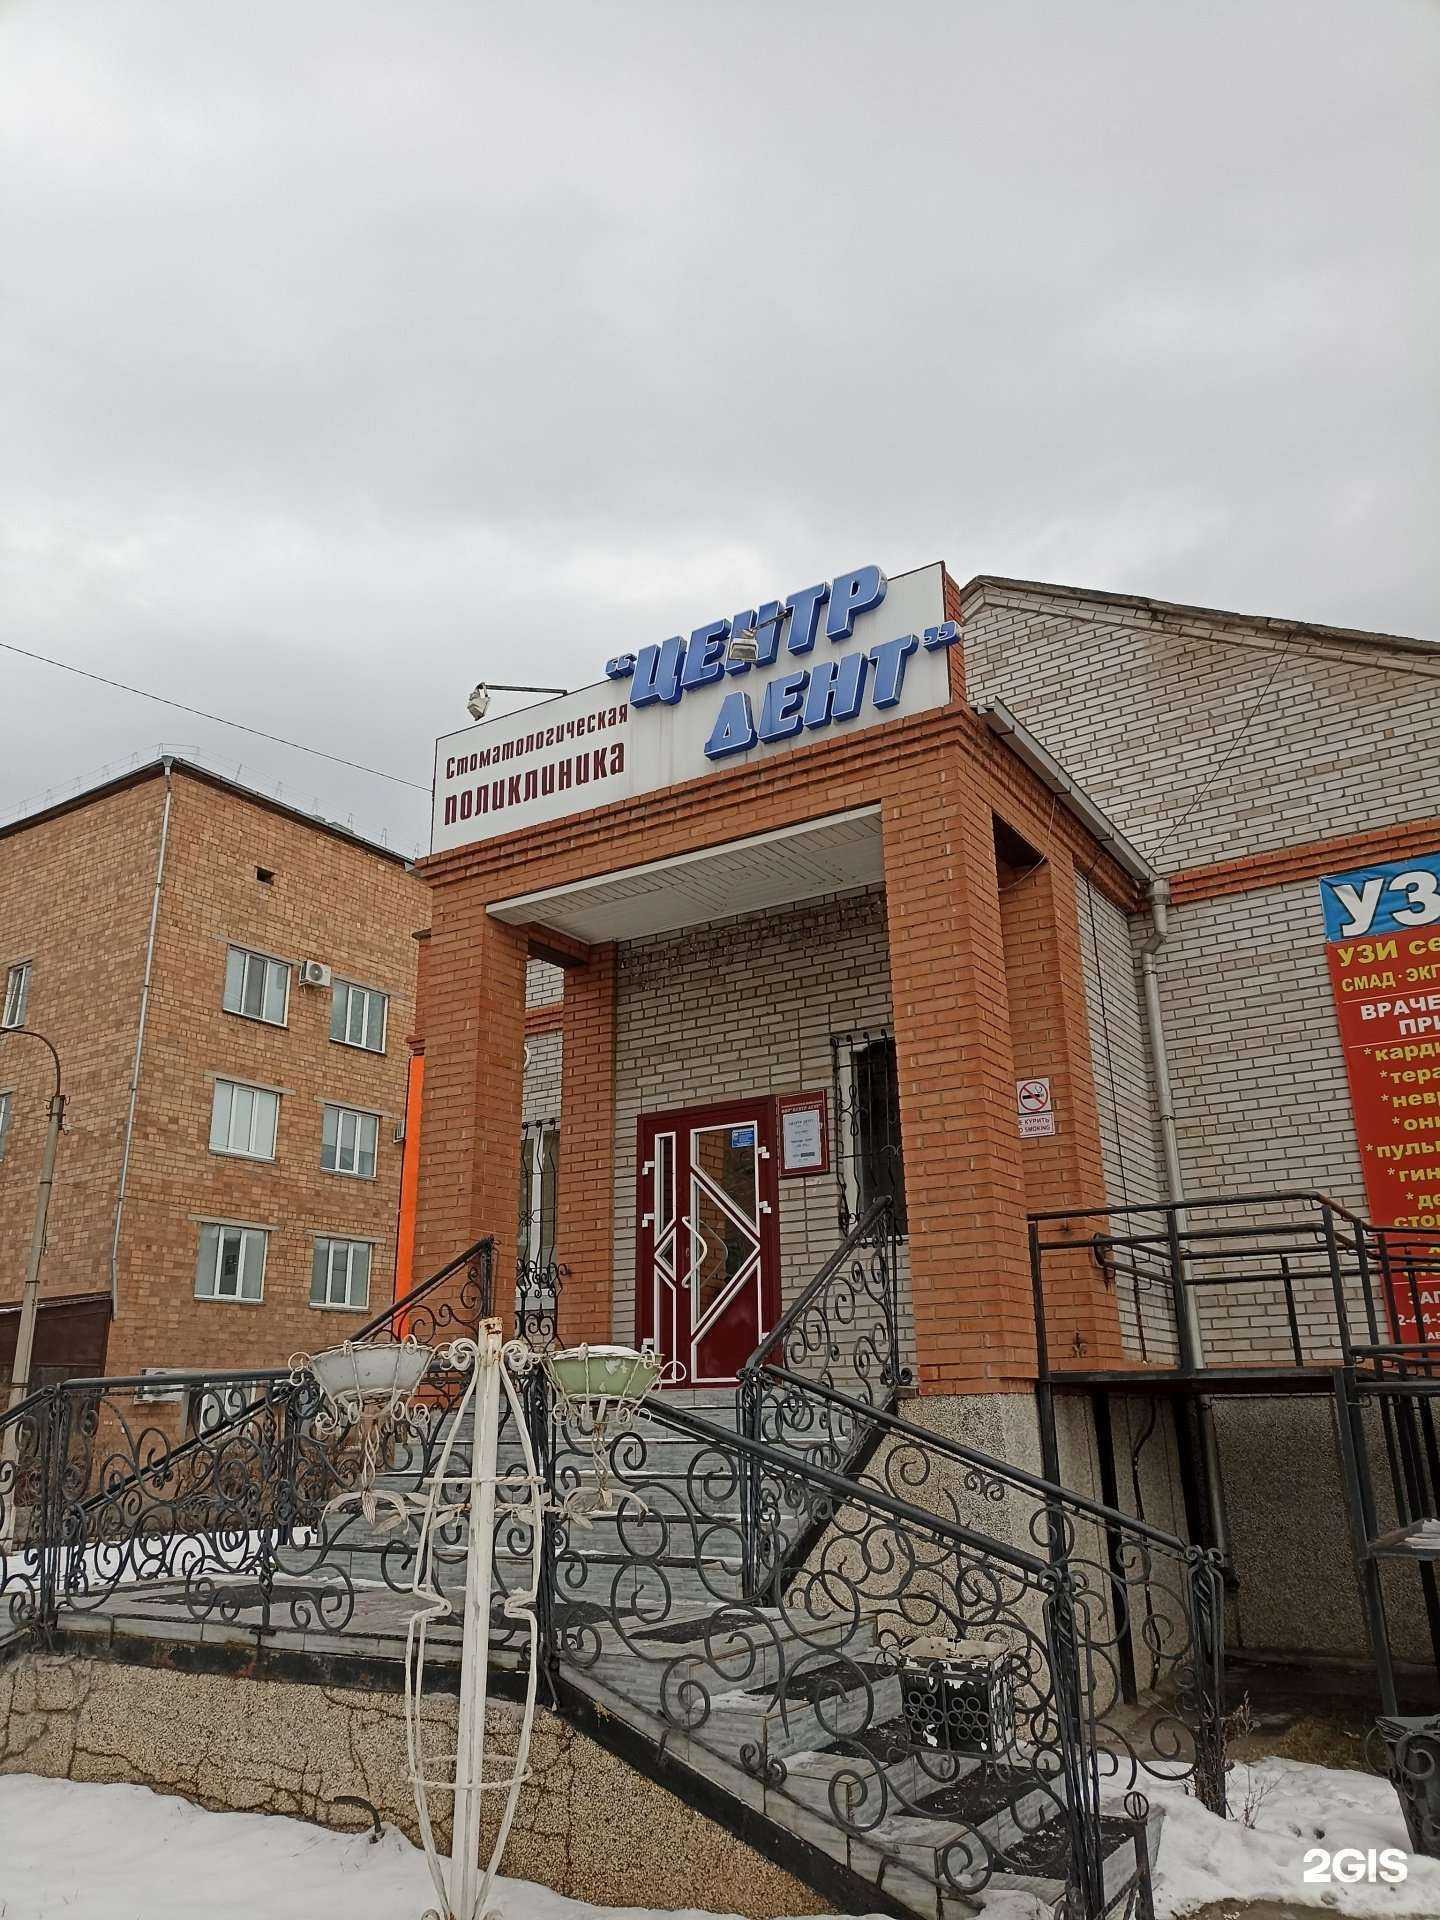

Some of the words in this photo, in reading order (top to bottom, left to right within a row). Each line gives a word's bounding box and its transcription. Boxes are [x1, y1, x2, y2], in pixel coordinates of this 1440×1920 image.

[446, 704, 628, 780] Стоматологическая
[444, 742, 625, 826] поликлиника
[1337, 939, 1398, 967] УЗИ
[1341, 971, 1397, 992] СМАД
[1360, 994, 1440, 1020] ВРАЧЕ
[1392, 1091, 1440, 1108] нев
